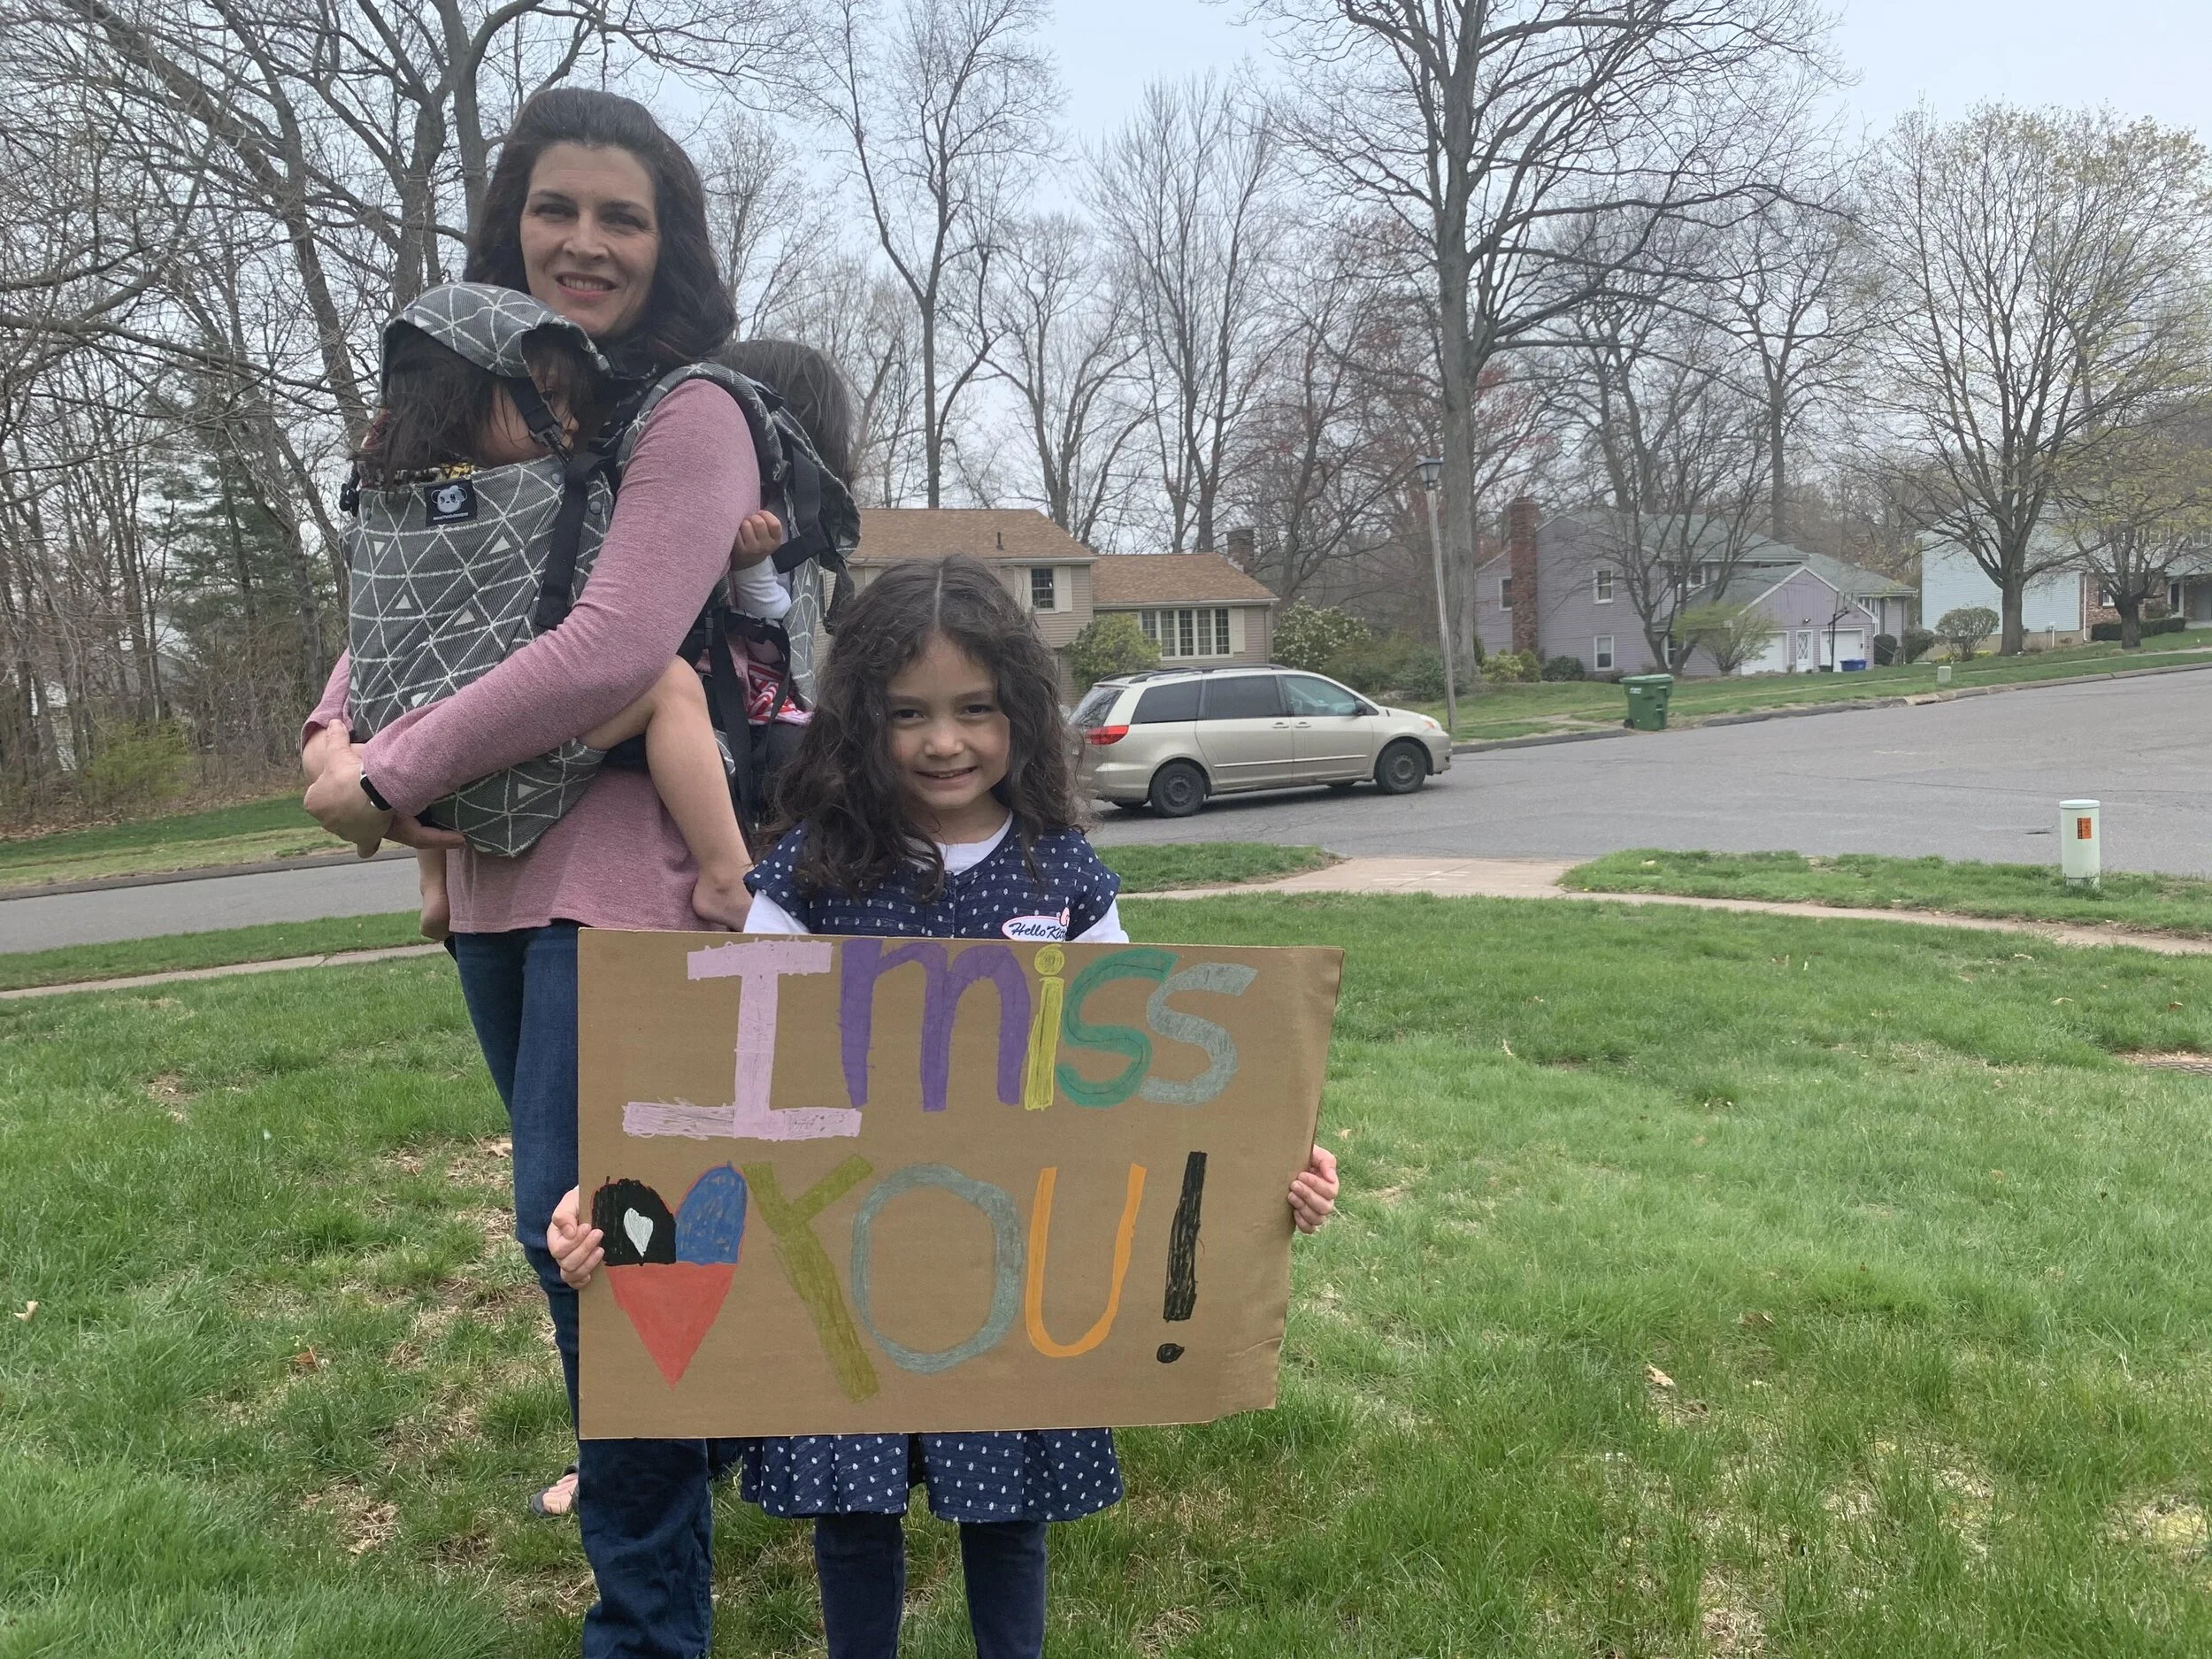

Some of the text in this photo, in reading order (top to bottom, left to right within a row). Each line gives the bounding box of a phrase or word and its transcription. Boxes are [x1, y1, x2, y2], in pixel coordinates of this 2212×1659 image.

[1009, 922, 1046, 936] Hello
[622, 937, 862, 1141] I
[741, 1151, 1208, 1403] YOU!
